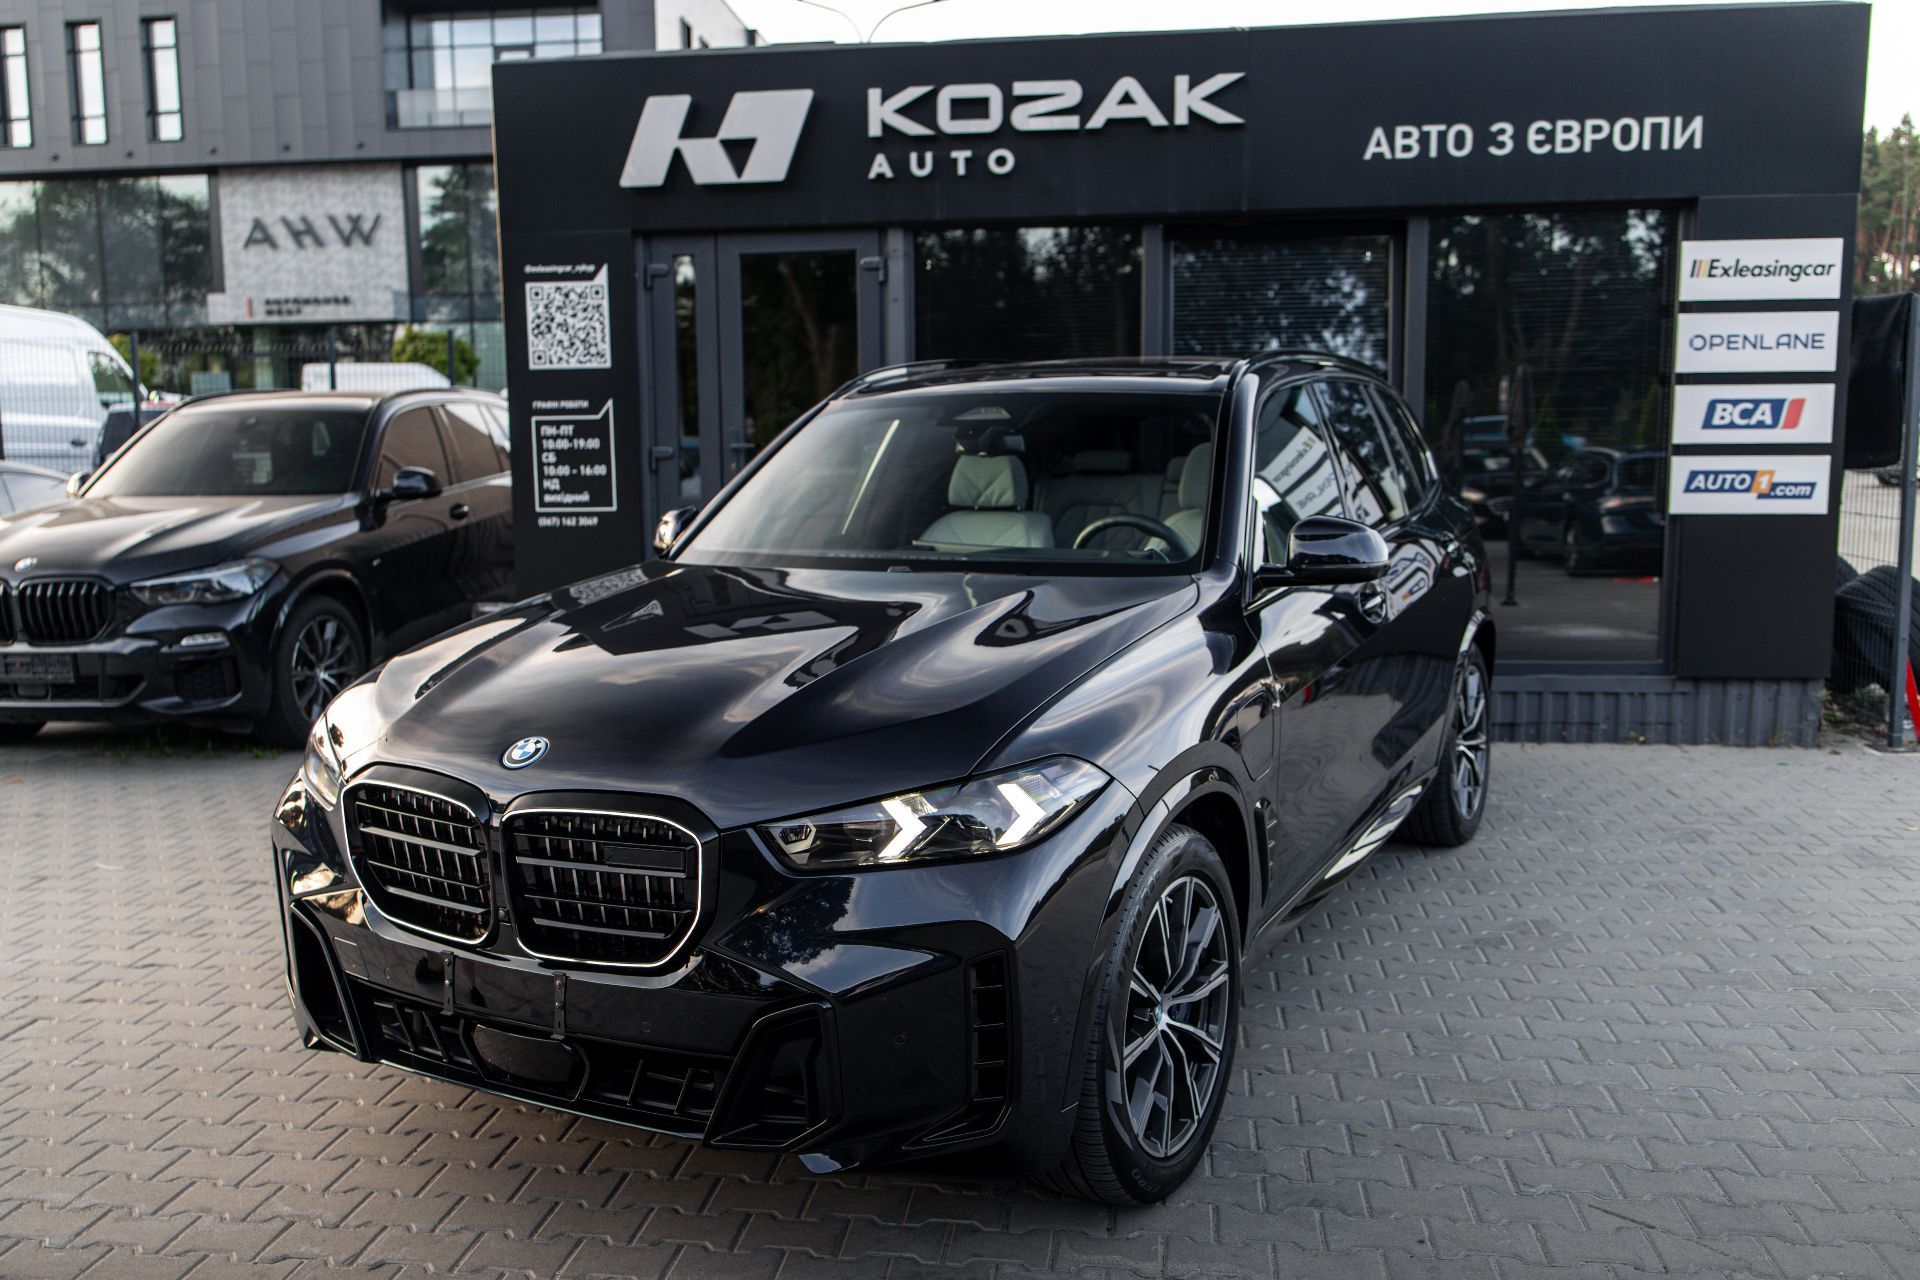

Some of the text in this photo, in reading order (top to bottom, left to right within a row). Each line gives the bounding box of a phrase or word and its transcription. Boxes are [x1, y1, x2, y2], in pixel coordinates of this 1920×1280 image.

[867, 71, 1247, 138] KOZAK
[1362, 115, 1704, 160] АВТО З ЄВРОПИ
[866, 147, 1016, 180] AUTO
[243, 213, 381, 250] AHW
[1707, 258, 1835, 283] Exleasingcar
[1689, 332, 1826, 352] OPENLANE
[1711, 402, 1774, 426] BCA
[540, 425, 574, 436] ПН-ПТ
[542, 452, 557, 463] СБ
[543, 478, 560, 490] НД
